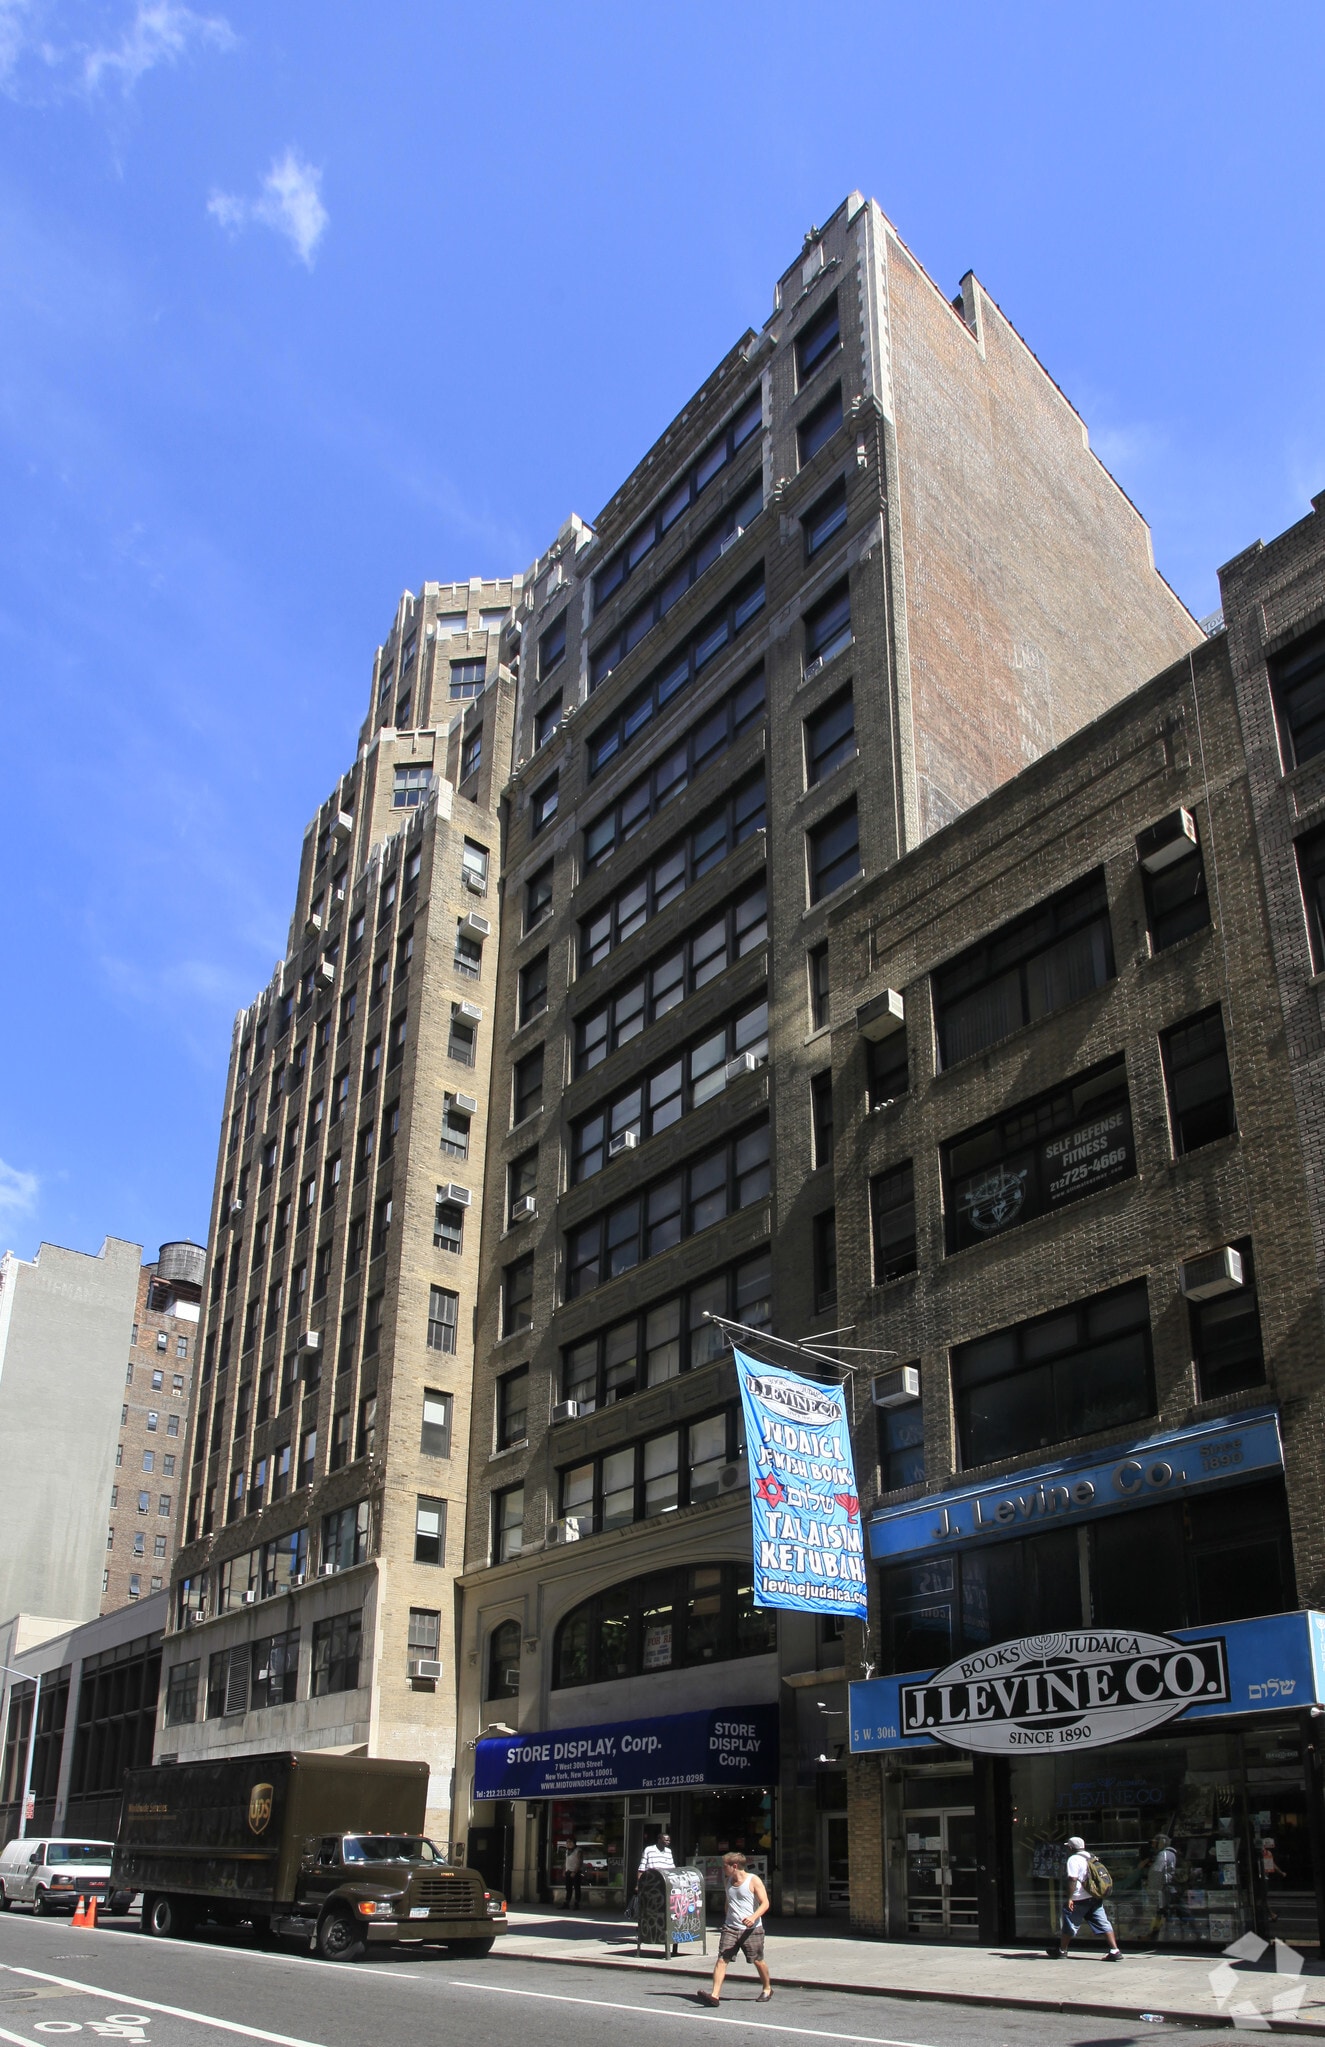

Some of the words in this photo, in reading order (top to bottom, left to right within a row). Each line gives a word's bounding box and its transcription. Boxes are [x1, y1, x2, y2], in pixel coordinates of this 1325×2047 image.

[1046, 1137, 1071, 1159] SELF
[1073, 1112, 1124, 1146] DEFENSE
[1062, 1136, 1108, 1167] FITNESS
[1200, 1437, 1243, 1458] Since
[758, 1445, 809, 1479] JEWISH
[1203, 1451, 1243, 1472] 1890
[786, 1483, 835, 1514] שלום
[931, 1509, 960, 1539] J.
[973, 1480, 1096, 1529] Levine
[1111, 1460, 1187, 1495] Co.
[765, 1510, 863, 1554] TALAISIM
[960, 1646, 1021, 1679] BOOKS
[1065, 1636, 1142, 1655] JUDAICA
[1125, 1652, 1218, 1702] CO.
[1248, 1678, 1296, 1700] שלום
[714, 1722, 756, 1737] STORE
[854, 1729, 860, 1742] 5
[863, 1728, 874, 1740] W.
[877, 1726, 897, 1739] 30th
[1009, 1731, 1054, 1744] SINCE
[1059, 1725, 1092, 1743] 1890
[507, 1744, 551, 1764] STORE
[554, 1737, 617, 1760] DISPLAY,
[621, 1735, 662, 1754] Corp.
[709, 1736, 761, 1752] DISPLAY
[555, 1763, 559, 1771] 7
[559, 1762, 572, 1771] West
[573, 1761, 586, 1770] 30th
[586, 1760, 603, 1769] Street
[719, 1753, 751, 1769] Corp.
[541, 1777, 618, 1790] WWW.MIDTOWNDISPLAY.COM
[545, 1773, 556, 1781] New
[570, 1771, 582, 1779] New
[582, 1770, 594, 1778] York
[595, 1768, 613, 1777] 10001
[657, 1773, 704, 1786] 212.213.0298
[250, 1798, 270, 1826] ups
[509, 1800, 516, 1812] 7
